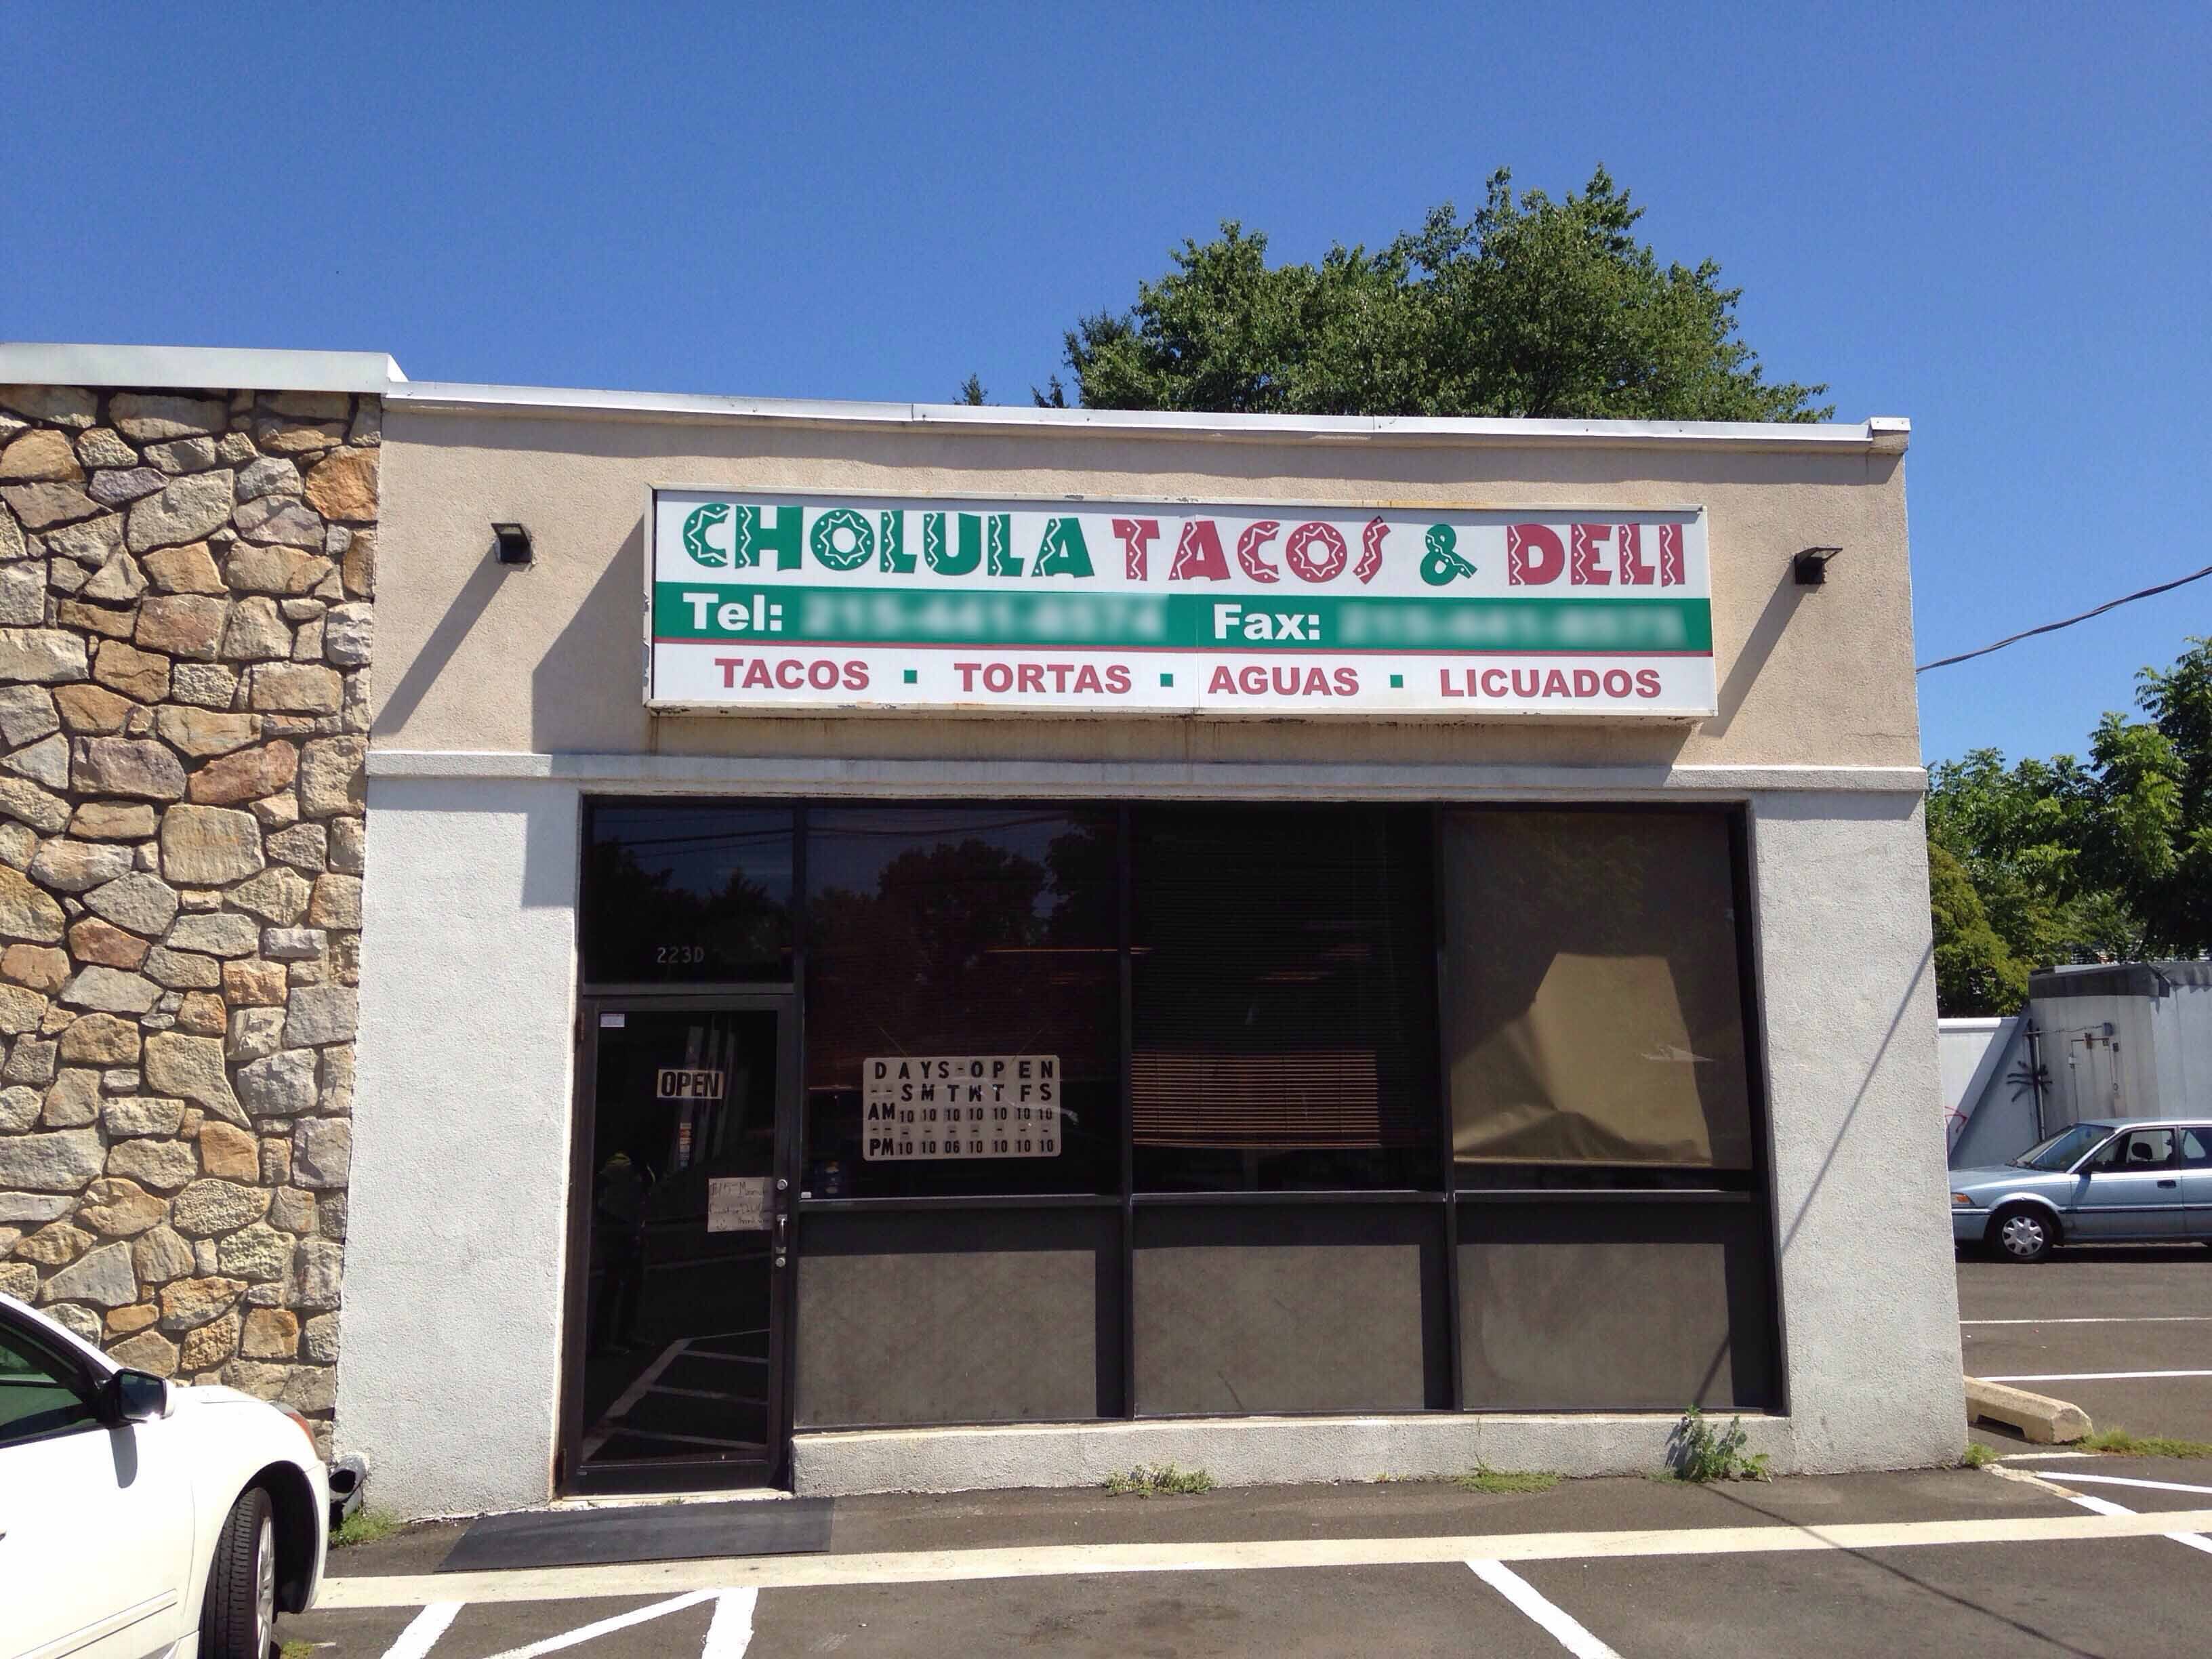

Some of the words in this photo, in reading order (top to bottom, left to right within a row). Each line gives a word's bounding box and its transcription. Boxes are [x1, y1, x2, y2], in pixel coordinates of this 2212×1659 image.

[682, 503, 1095, 577] CHOLULA
[1111, 516, 1391, 585] TACOS
[1420, 524, 1478, 586] &
[1507, 523, 1685, 588] DELI
[682, 593, 783, 632] Tel:
[1213, 605, 1320, 640] Fax:
[714, 658, 869, 691] TACOS
[954, 662, 1132, 695] TORTAS
[1208, 665, 1359, 697] AGUAS
[1440, 668, 1662, 699] LICUADOS
[660, 1071, 719, 1097] OPEN
[867, 1103, 895, 1120] AM
[869, 1139, 894, 1156] PM
